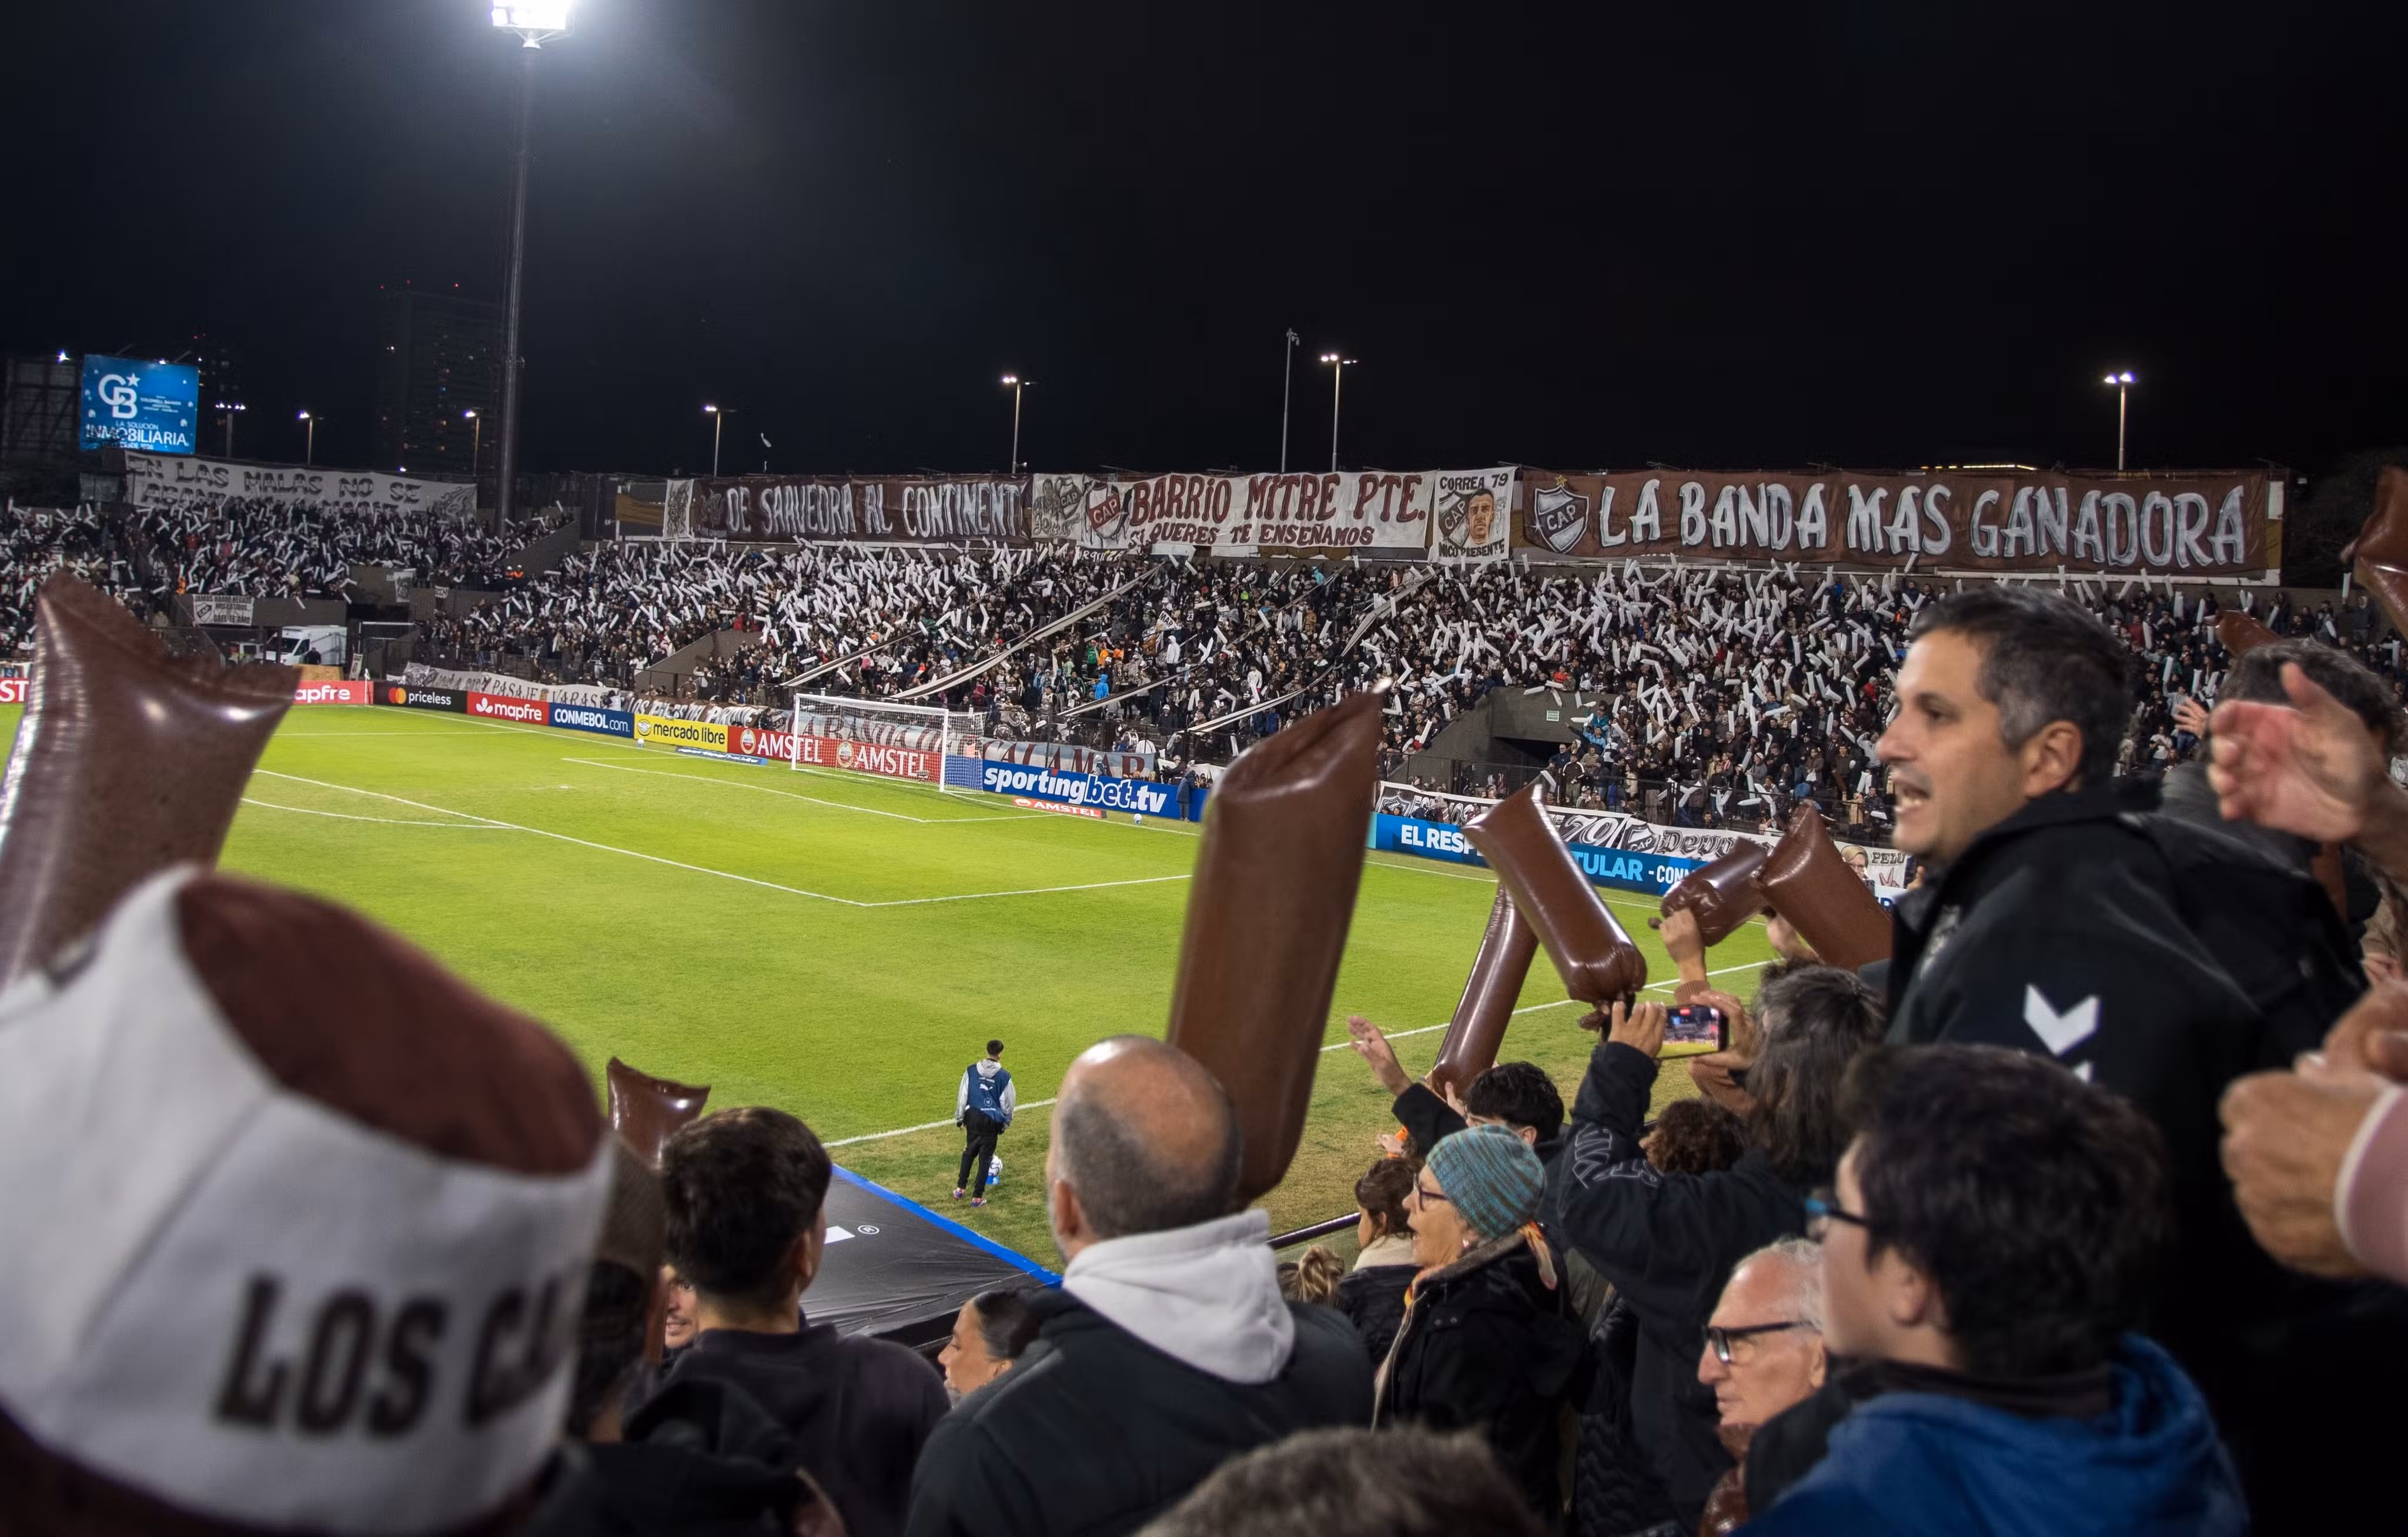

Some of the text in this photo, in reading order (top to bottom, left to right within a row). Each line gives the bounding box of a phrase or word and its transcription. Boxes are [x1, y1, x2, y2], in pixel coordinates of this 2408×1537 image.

[126, 455, 163, 479] EN
[176, 461, 229, 488] LAS
[243, 470, 323, 495] MALAS
[339, 477, 374, 498] NO
[389, 482, 422, 504] SE
[1440, 473, 1509, 490] CORREA 79
[726, 486, 751, 533] DE
[761, 483, 857, 536] SAAVEDRA
[864, 484, 893, 533] AL
[1093, 500, 1119, 524] CAP
[1444, 500, 1466, 530] CAP
[1546, 504, 1577, 530] CAP
[1149, 522, 1220, 544] QUERES
[1230, 524, 1252, 544] TE
[1259, 523, 1375, 546] ENSEÑAMOS
[1599, 479, 2246, 569] LA BANDA MAS GANADORA
[1439, 537, 1505, 557] NICO PRESENTE
[294, 684, 351, 703] apfre
[409, 691, 452, 706] priceless
[494, 702, 542, 721] mapfre
[653, 723, 725, 744] mercado libre
[757, 733, 823, 763] AMSTEL
[855, 746, 926, 777] AMSTEL
[984, 767, 1168, 813] sportingbet.tv
[1034, 801, 1101, 818] AMSTEL
[1402, 824, 1424, 847] EL
[1426, 828, 1484, 857] RESP
[1872, 851, 1906, 864] PELU
[214, 1272, 449, 1438] LOS
